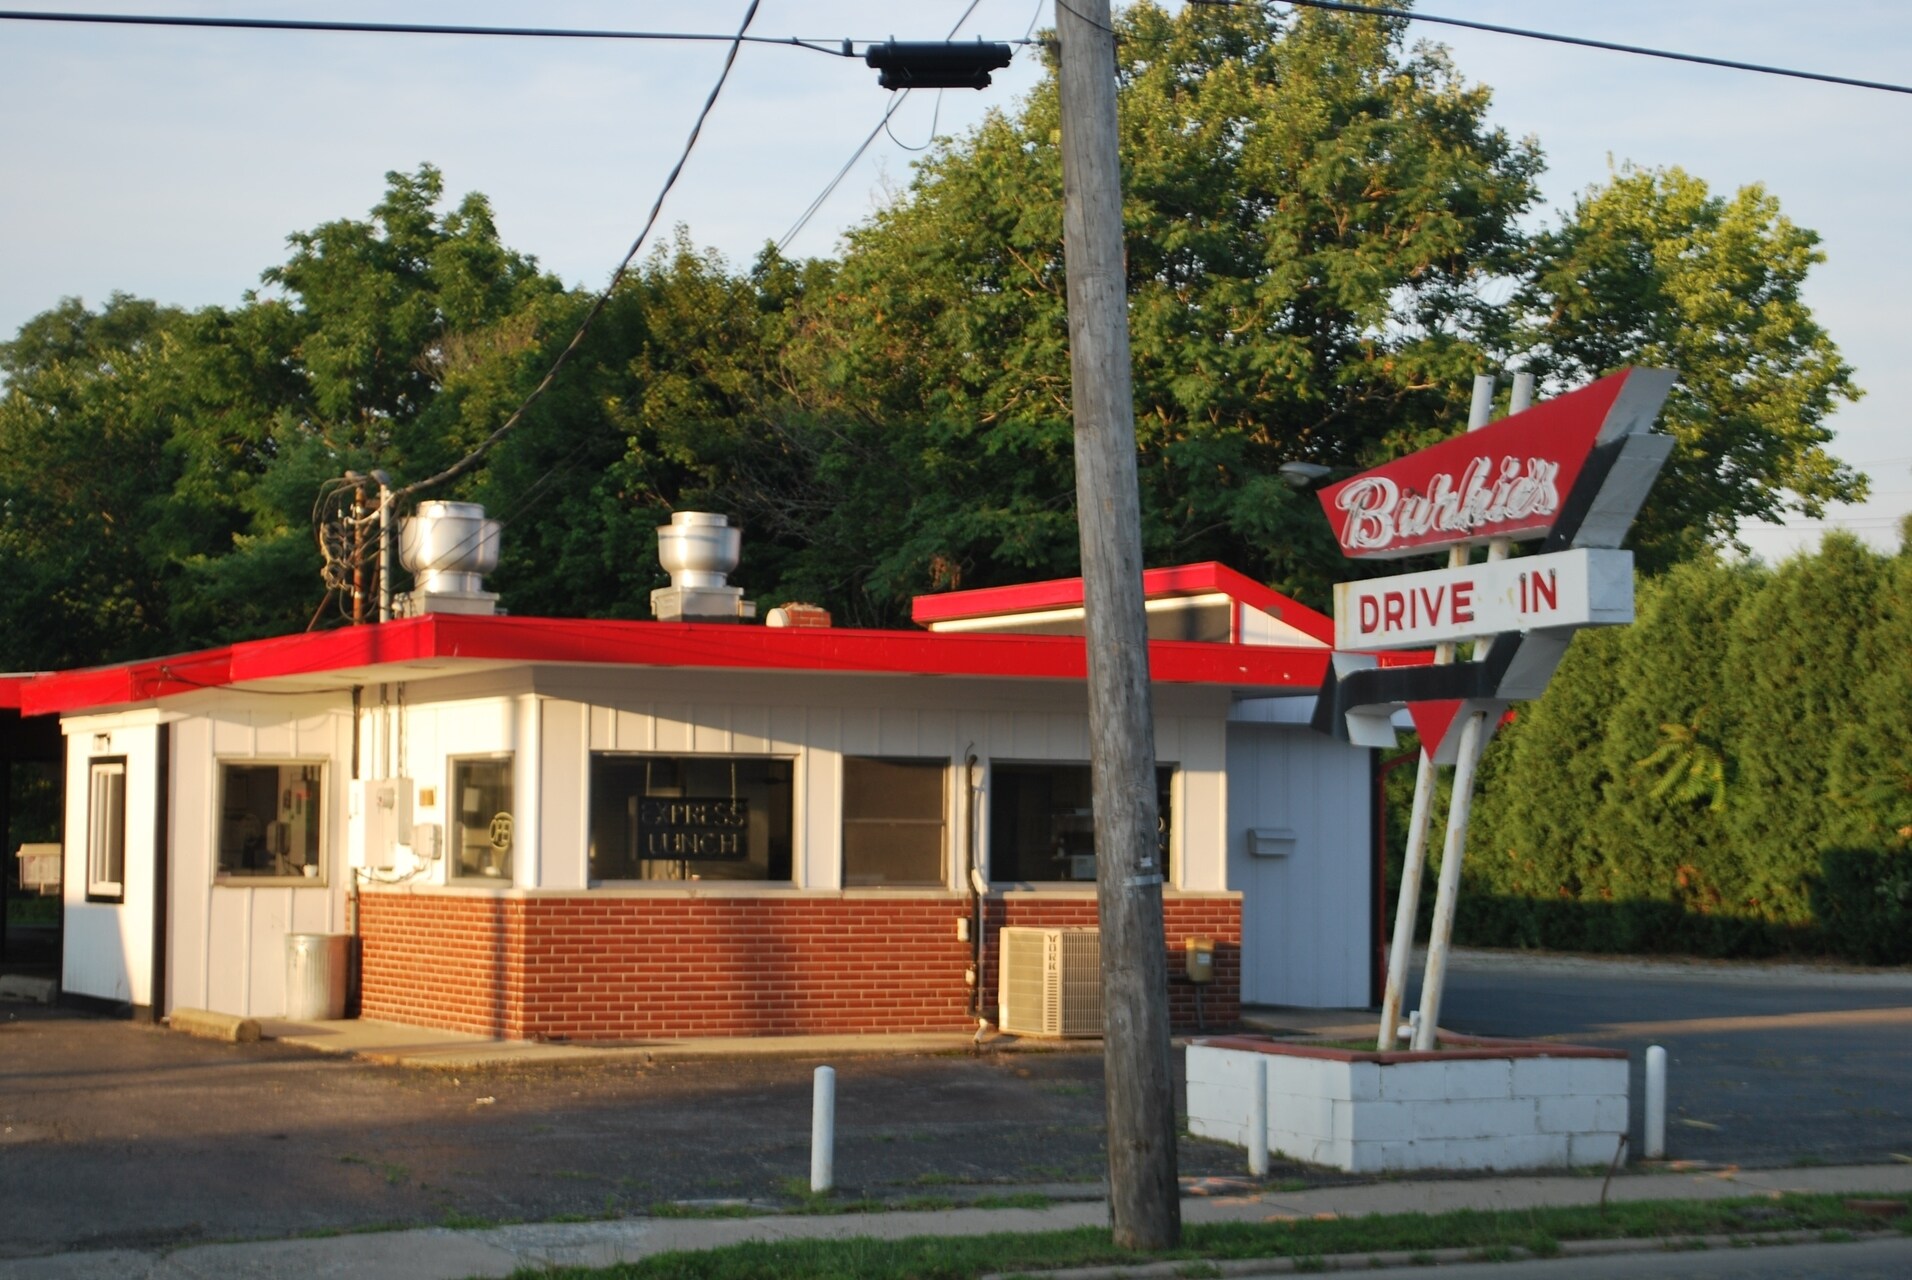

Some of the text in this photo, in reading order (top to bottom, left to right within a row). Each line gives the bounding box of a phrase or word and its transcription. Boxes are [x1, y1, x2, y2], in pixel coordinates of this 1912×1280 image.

[1360, 568, 1557, 634] DRIVE IN
[640, 803, 745, 826] EXPRESS
[648, 832, 738, 854] LUNCH
[1047, 934, 1058, 970] YORK
